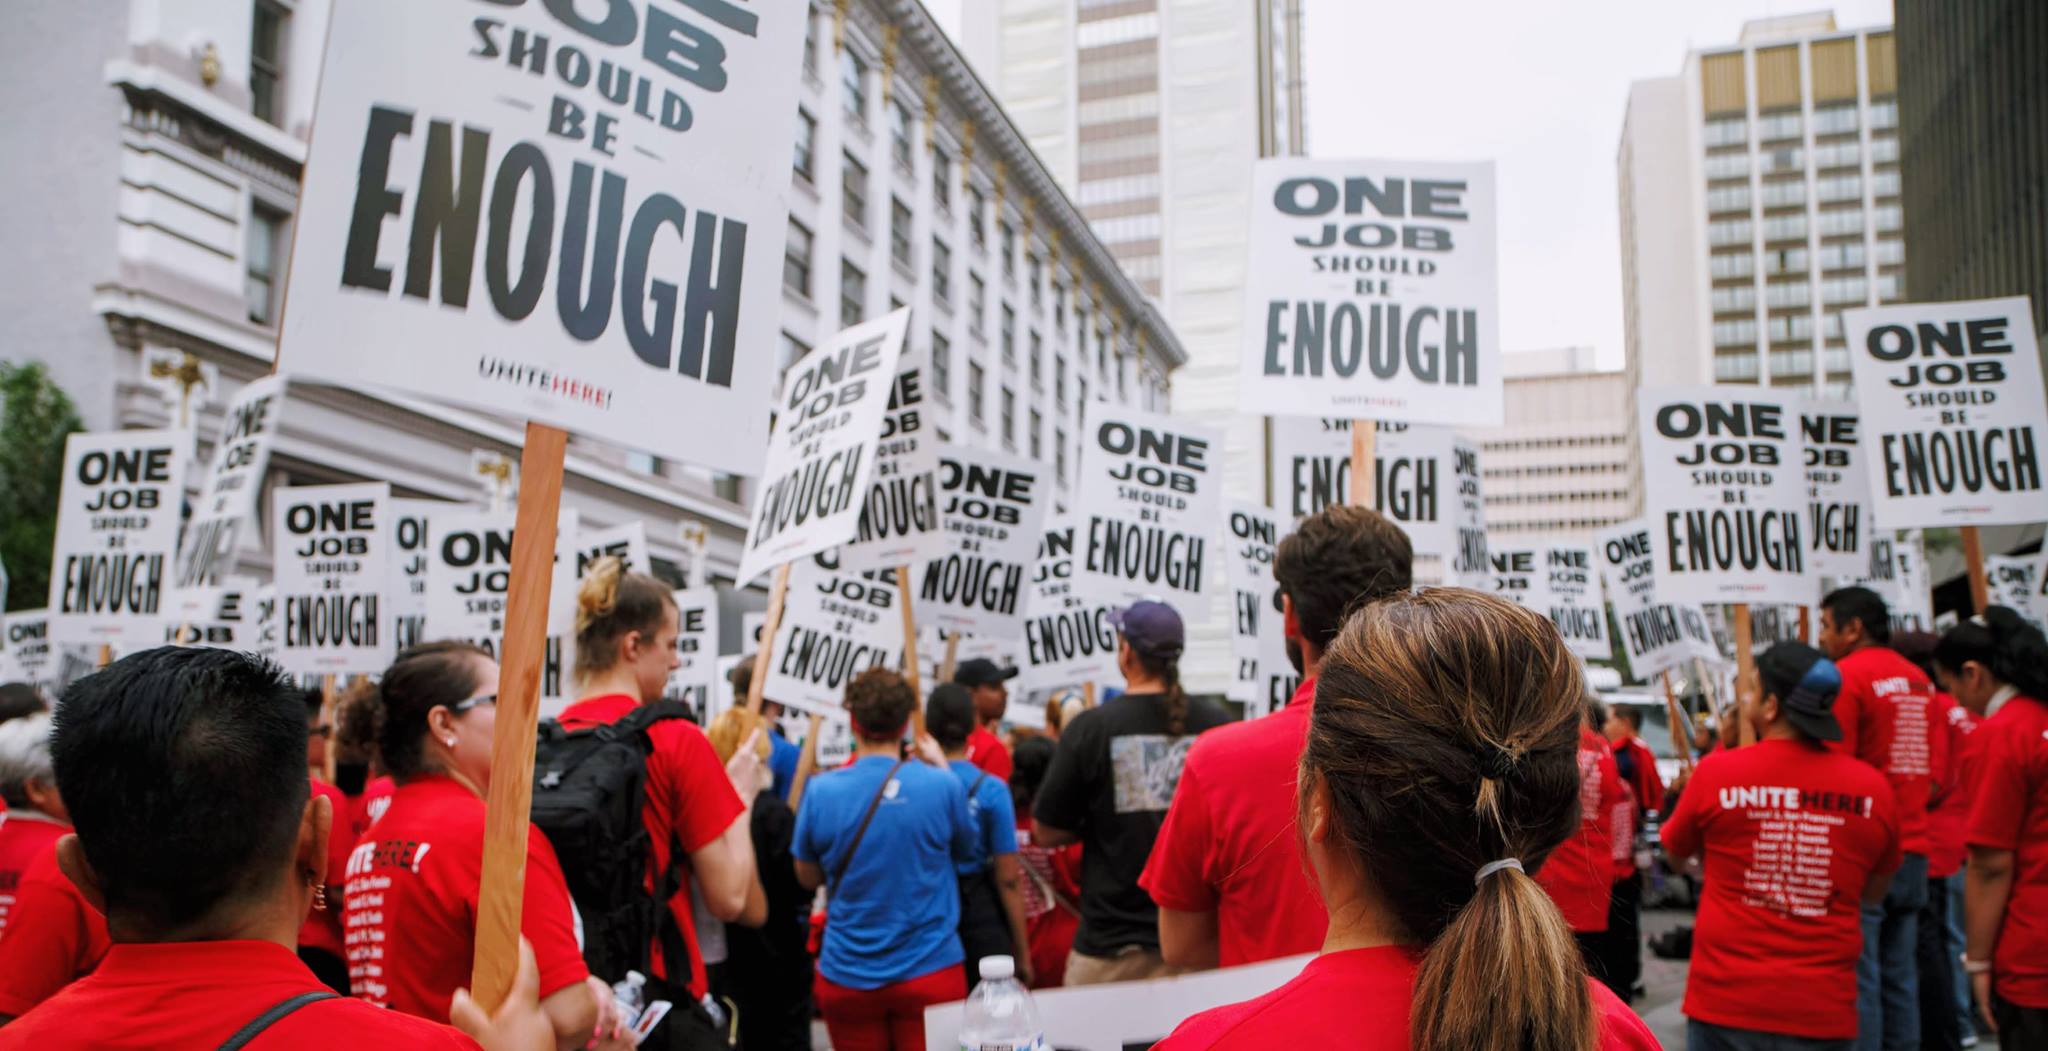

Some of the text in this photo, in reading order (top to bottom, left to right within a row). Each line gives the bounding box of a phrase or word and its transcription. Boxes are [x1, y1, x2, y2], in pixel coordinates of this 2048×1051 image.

[466, 0, 728, 92] OB
[468, 18, 694, 132] SHOULD
[546, 95, 619, 158] BE
[1273, 177, 1468, 221] ONE
[341, 105, 748, 389] ENOUGH
[1293, 223, 1454, 252] JOB
[1311, 255, 1437, 275] SHOULD
[1355, 278, 1392, 296] BE
[1263, 300, 1478, 386] ENOUGH
[1867, 317, 2013, 361] ONE
[788, 333, 886, 410] ONE
[1889, 361, 2006, 387] JOB
[789, 380, 866, 432] JOB
[1906, 390, 1997, 408] SHOULD
[1941, 410, 1967, 424] BE
[1657, 403, 1786, 439] ONE
[1801, 415, 1858, 444] NE
[1098, 422, 1208, 472] ONE
[1676, 443, 1780, 466] JOB
[1882, 427, 2041, 496] ENOUGH
[78, 448, 172, 485] ONE
[1109, 463, 1196, 494] JOB
[1692, 471, 1774, 485] SHOULD
[85, 489, 160, 511] JOB
[752, 442, 865, 549] ENOUGH
[1118, 486, 1187, 510] SHOULD
[1724, 489, 1746, 504] BE
[287, 502, 375, 534] ONE
[298, 537, 368, 556] JOB
[1086, 516, 1204, 592] ENOUGH
[1666, 509, 1803, 573] ENOUGH
[62, 554, 164, 614] ENOUGH
[817, 578, 893, 608] JOB
[922, 554, 1022, 615] NOUGH
[287, 596, 378, 646] ENOUGH
[1719, 786, 1873, 819] UNITEHERE!
